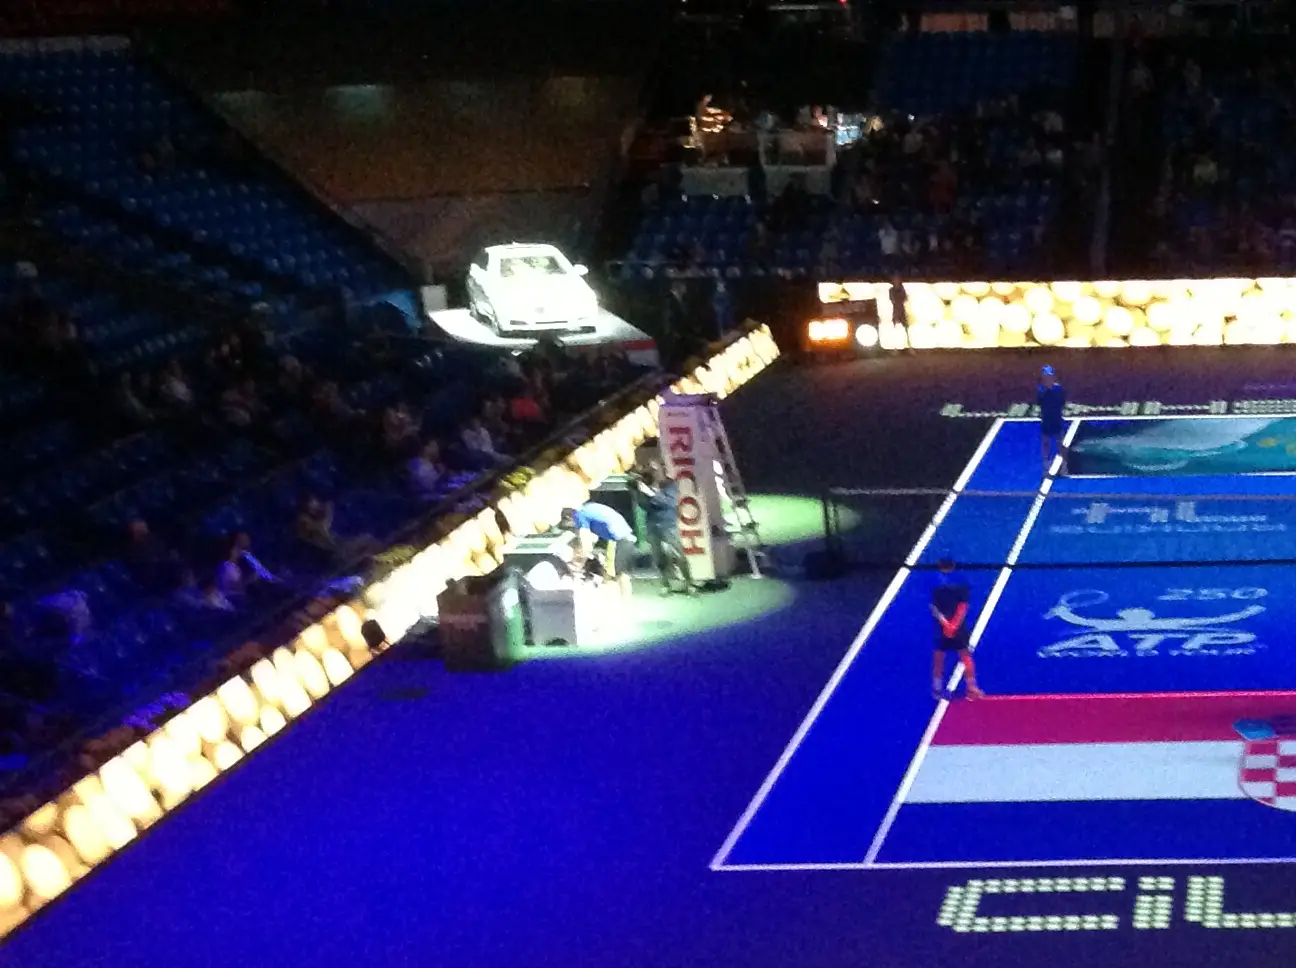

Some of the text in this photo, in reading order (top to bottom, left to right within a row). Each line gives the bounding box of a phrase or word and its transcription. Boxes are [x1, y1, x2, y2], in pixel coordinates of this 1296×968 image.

[668, 426, 705, 555] RICOH
[1157, 586, 1268, 601] 250
[1040, 632, 1258, 652] ATP
